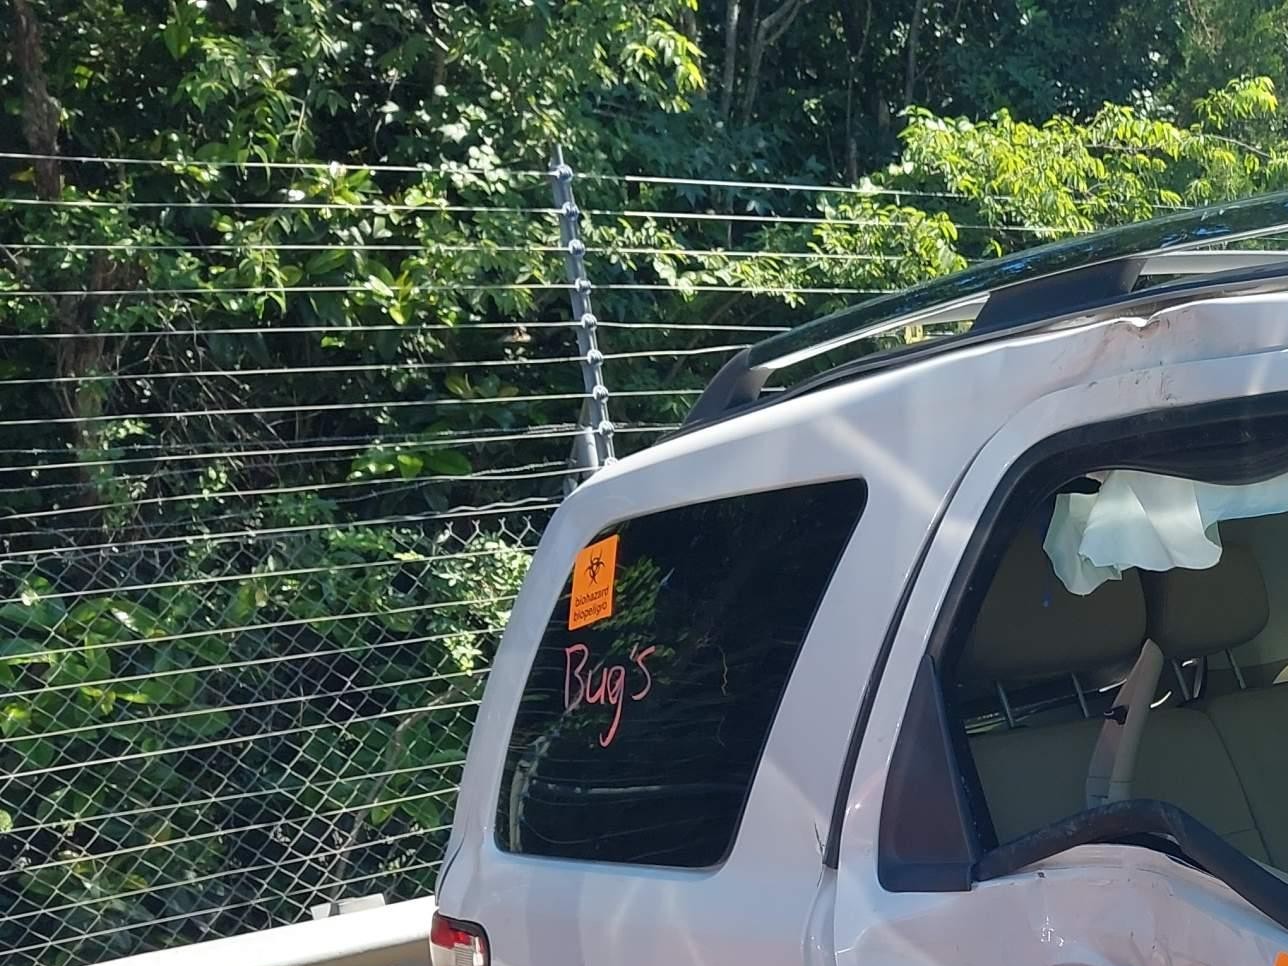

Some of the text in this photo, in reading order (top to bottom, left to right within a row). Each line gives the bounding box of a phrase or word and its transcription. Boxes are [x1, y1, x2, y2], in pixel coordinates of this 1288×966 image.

[574, 586, 609, 607] biohazard
[573, 601, 608, 621] biopeligro
[564, 642, 656, 747] Bug's
